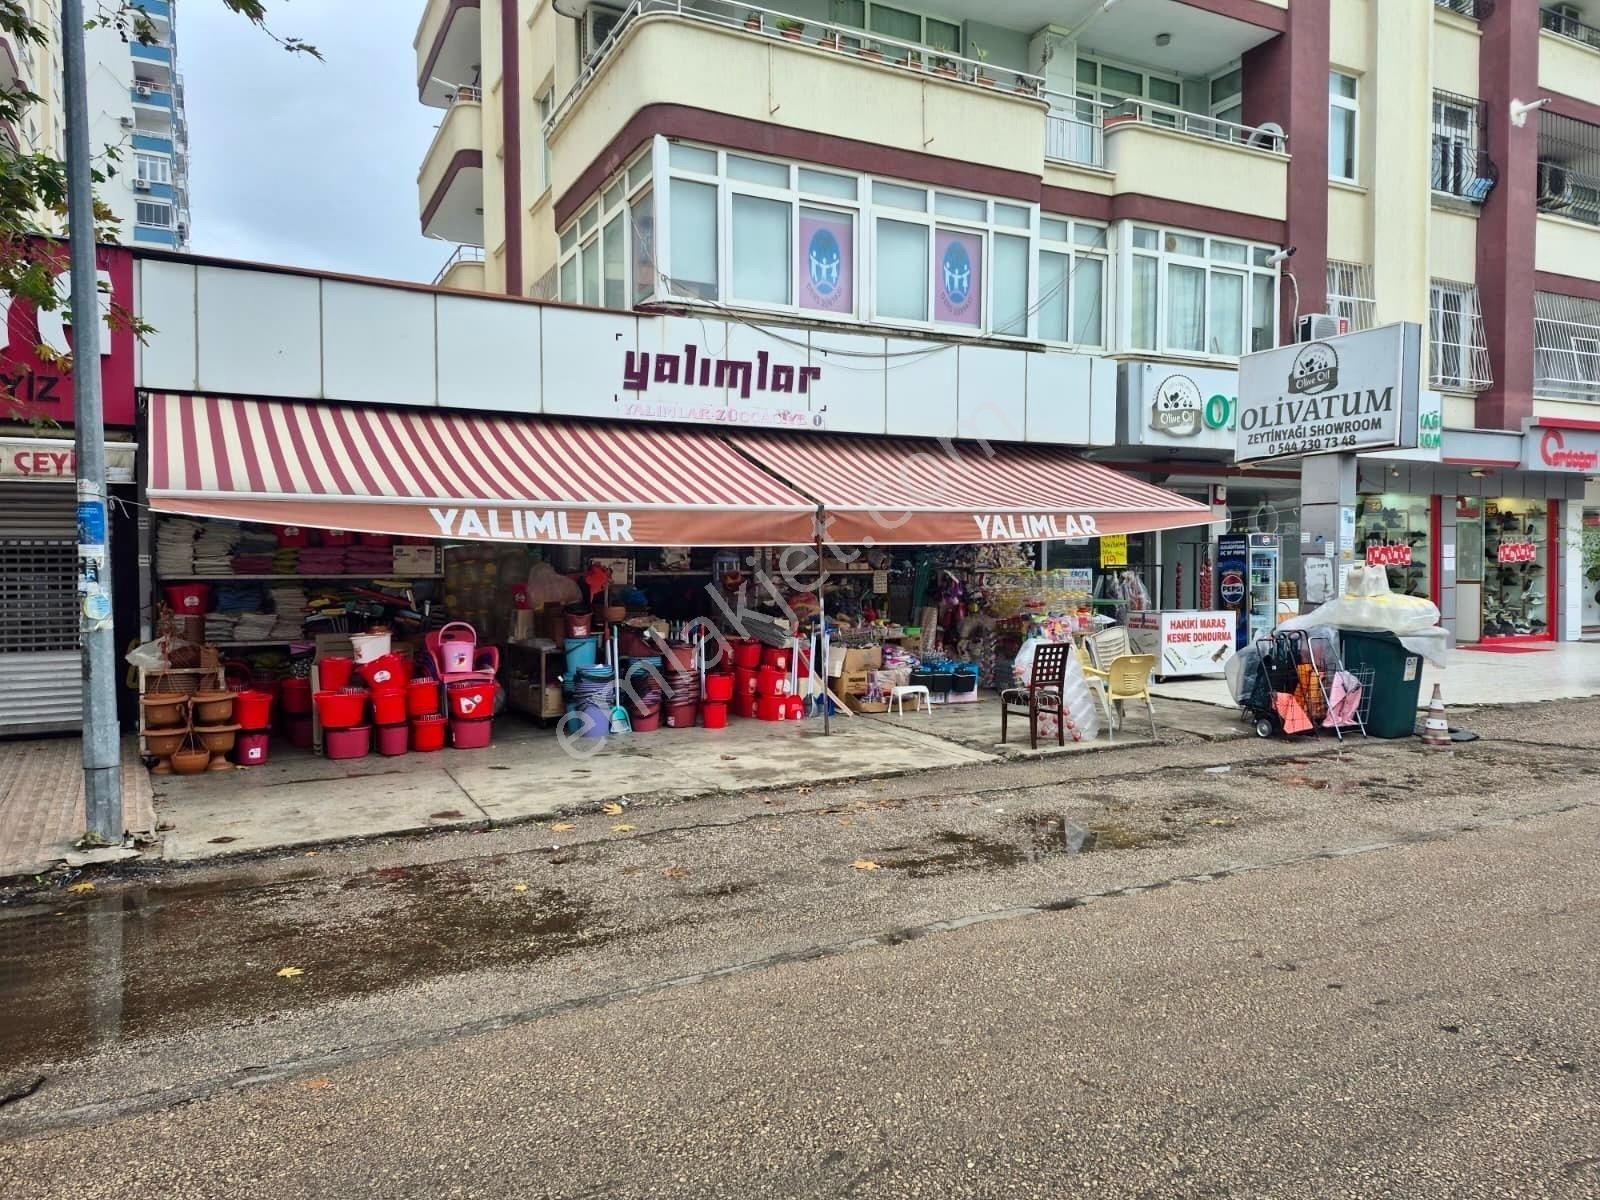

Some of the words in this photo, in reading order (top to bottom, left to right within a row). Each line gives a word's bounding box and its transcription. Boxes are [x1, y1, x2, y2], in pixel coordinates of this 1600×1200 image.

[1296, 377, 1316, 389] Olive
[1317, 369, 1330, 382] Oil
[1160, 412, 1181, 425] Olive
[1182, 410, 1195, 424] Oil
[1240, 386, 1394, 431] OLİVATUM
[1248, 424, 1307, 445] ZEYTİNYAĞI
[1310, 417, 1382, 437] SHOWROOM
[1268, 443, 1275, 455] 0
[1277, 441, 1298, 454] 544
[1301, 438, 1321, 450] 230
[1325, 436, 1338, 448] 73
[1341, 434, 1357, 446] 48
[429, 508, 634, 542] YALIMLAR
[973, 514, 1100, 540] YALIMLAR
[1199, 617, 1227, 631] MARAŞ
[1166, 633, 1192, 644] KESME
[1193, 631, 1232, 643] DONDURMA
